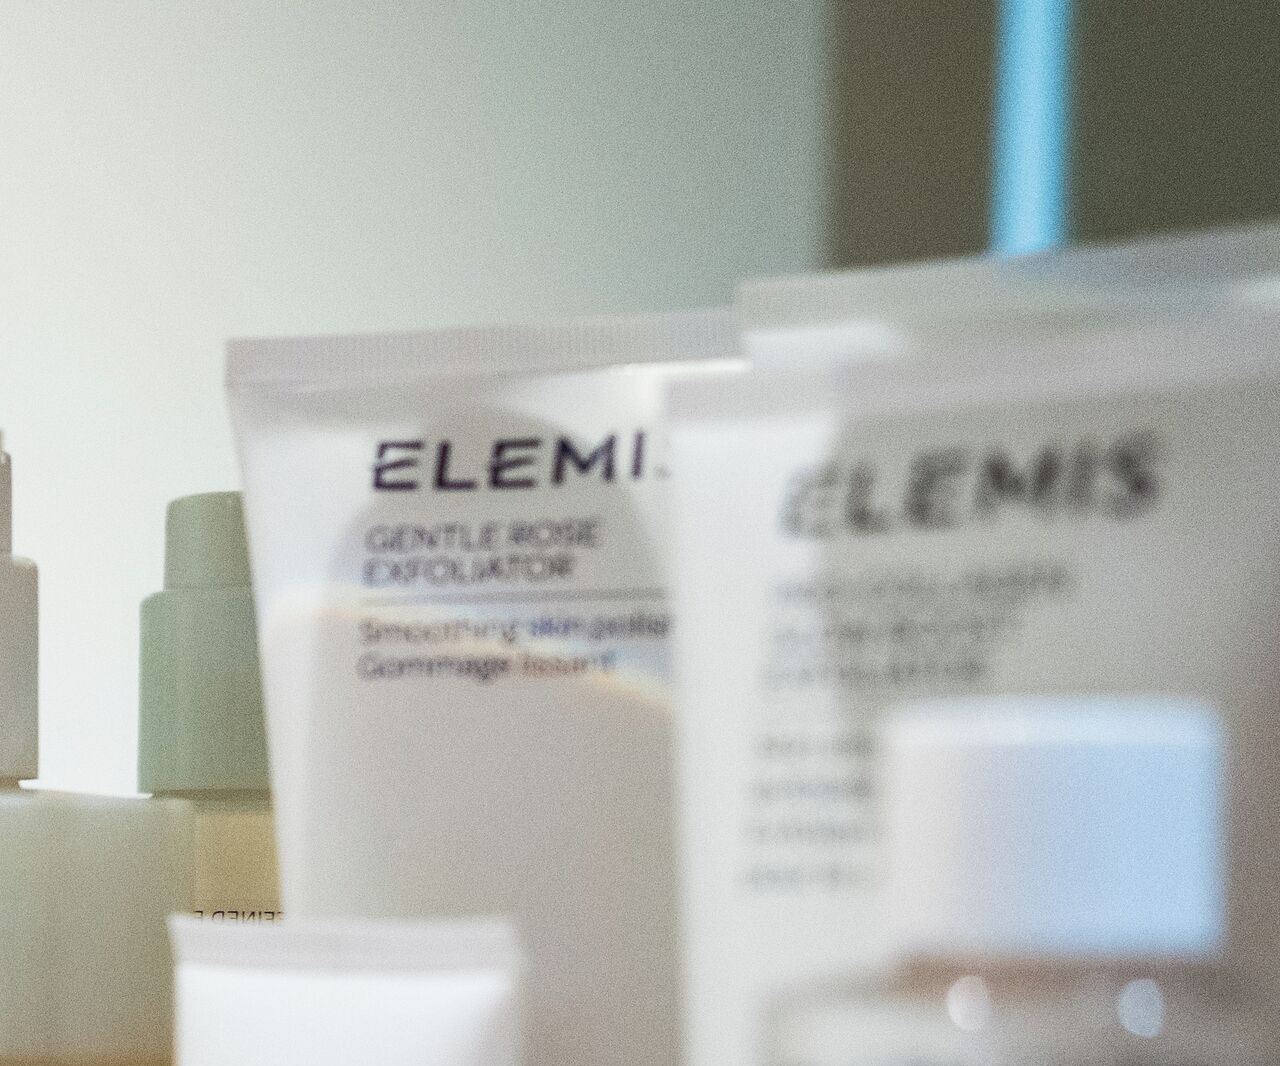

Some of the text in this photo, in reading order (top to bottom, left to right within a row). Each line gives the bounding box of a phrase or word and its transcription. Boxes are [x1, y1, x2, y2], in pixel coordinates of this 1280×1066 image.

[372, 428, 648, 492] ELEMI
[777, 430, 1162, 540] ELEMIS
[362, 516, 601, 554] GENTLE ROSE
[361, 553, 576, 588] EXFOLIATOR
